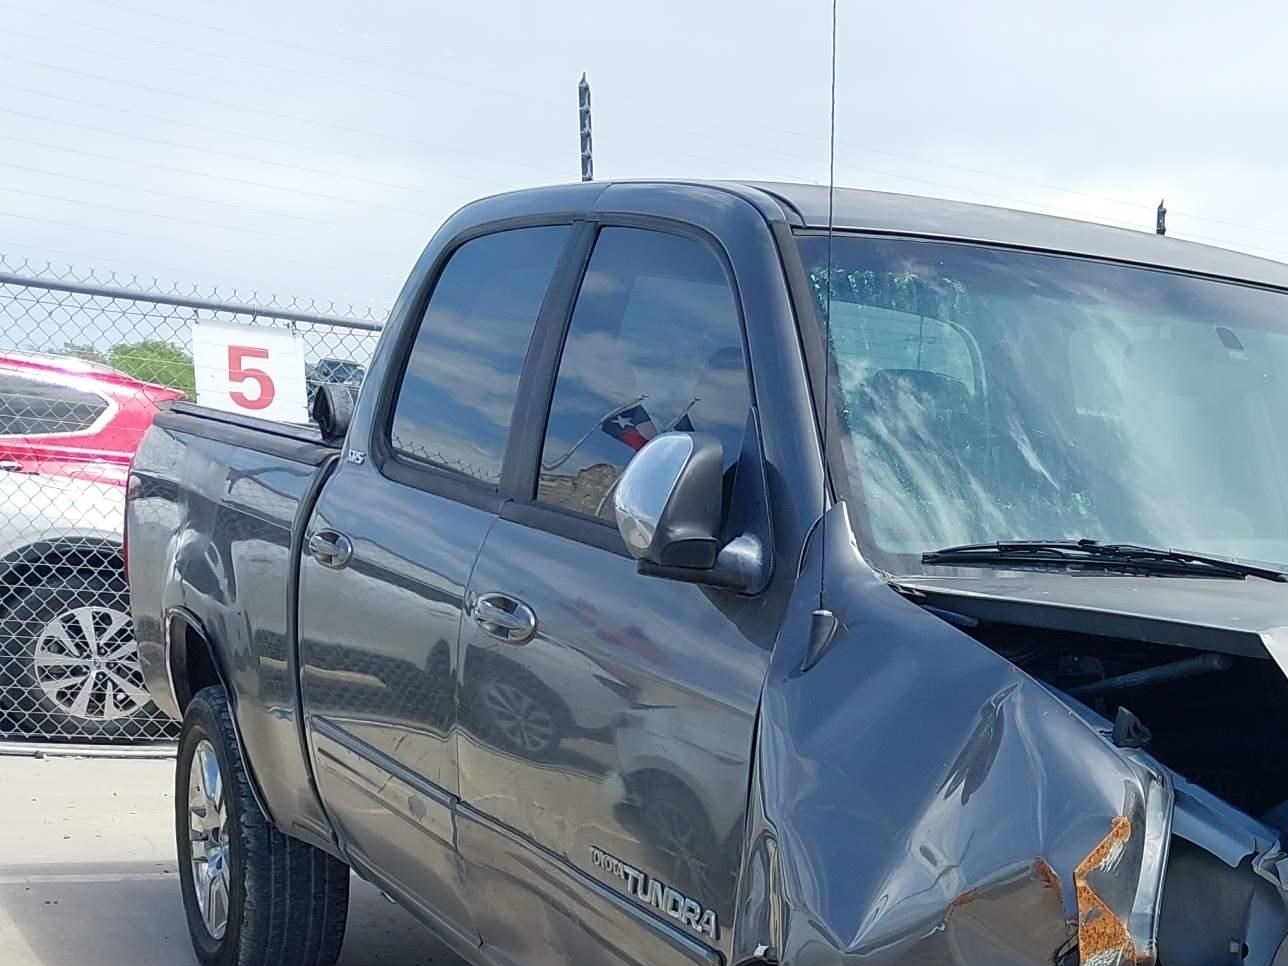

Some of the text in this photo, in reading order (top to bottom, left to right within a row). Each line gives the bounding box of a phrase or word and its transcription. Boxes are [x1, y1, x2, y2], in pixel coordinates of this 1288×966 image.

[228, 344, 275, 411] 5
[590, 846, 719, 940] TOYOTA TUNDRA
